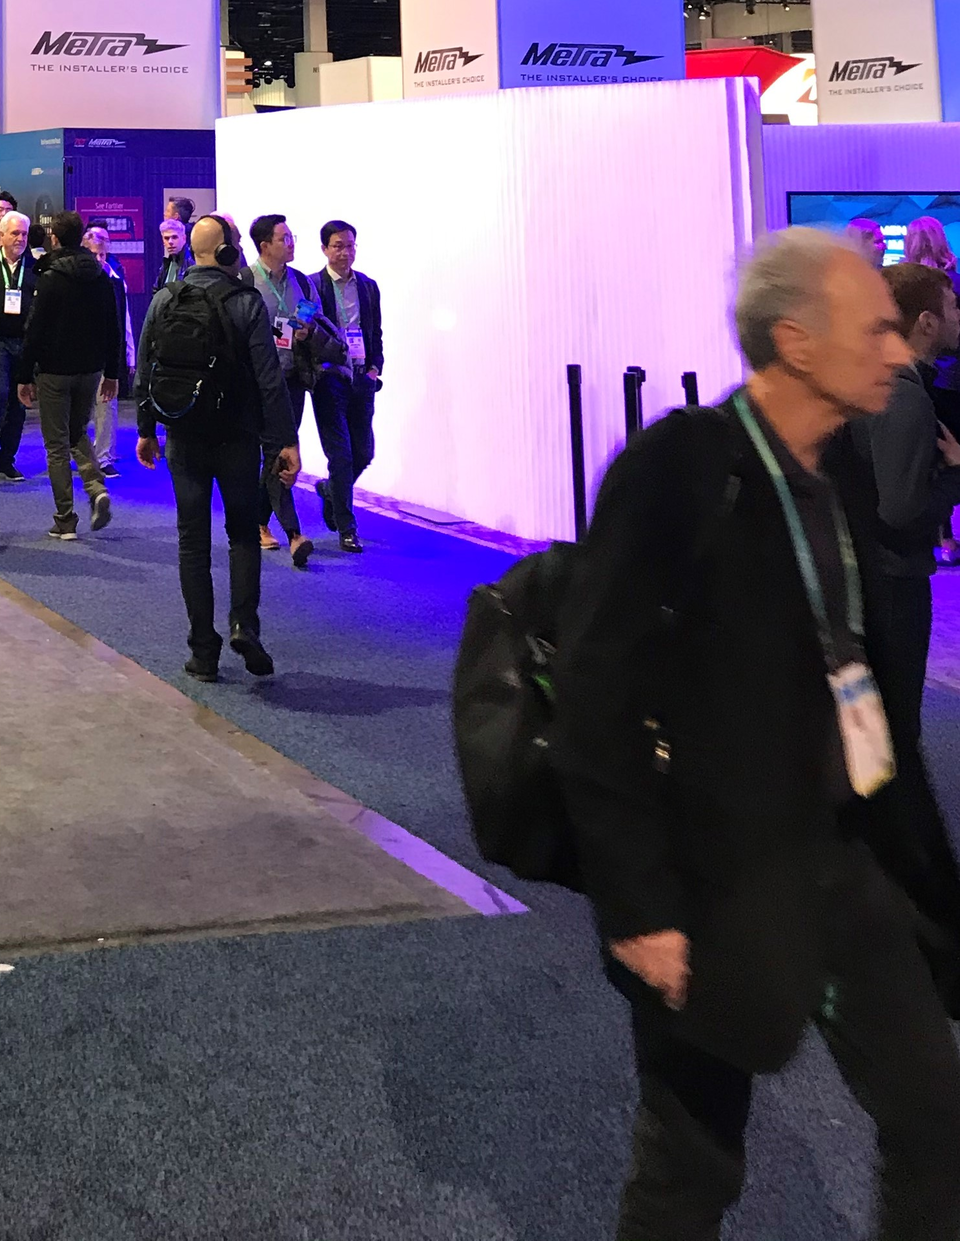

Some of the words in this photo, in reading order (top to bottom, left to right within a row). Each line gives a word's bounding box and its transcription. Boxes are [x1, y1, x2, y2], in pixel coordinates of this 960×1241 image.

[30, 63, 54, 72] THE
[59, 64, 138, 74] INSTALLER'S
[142, 65, 189, 74] CHOICE
[426, 77, 461, 87] INSTALLER'S
[462, 75, 485, 84] CHOICE
[520, 74, 543, 82] THE
[546, 74, 619, 83] INSTALLER'S
[844, 85, 892, 95] INSTALLER'S
[894, 83, 924, 92] CHOICE
